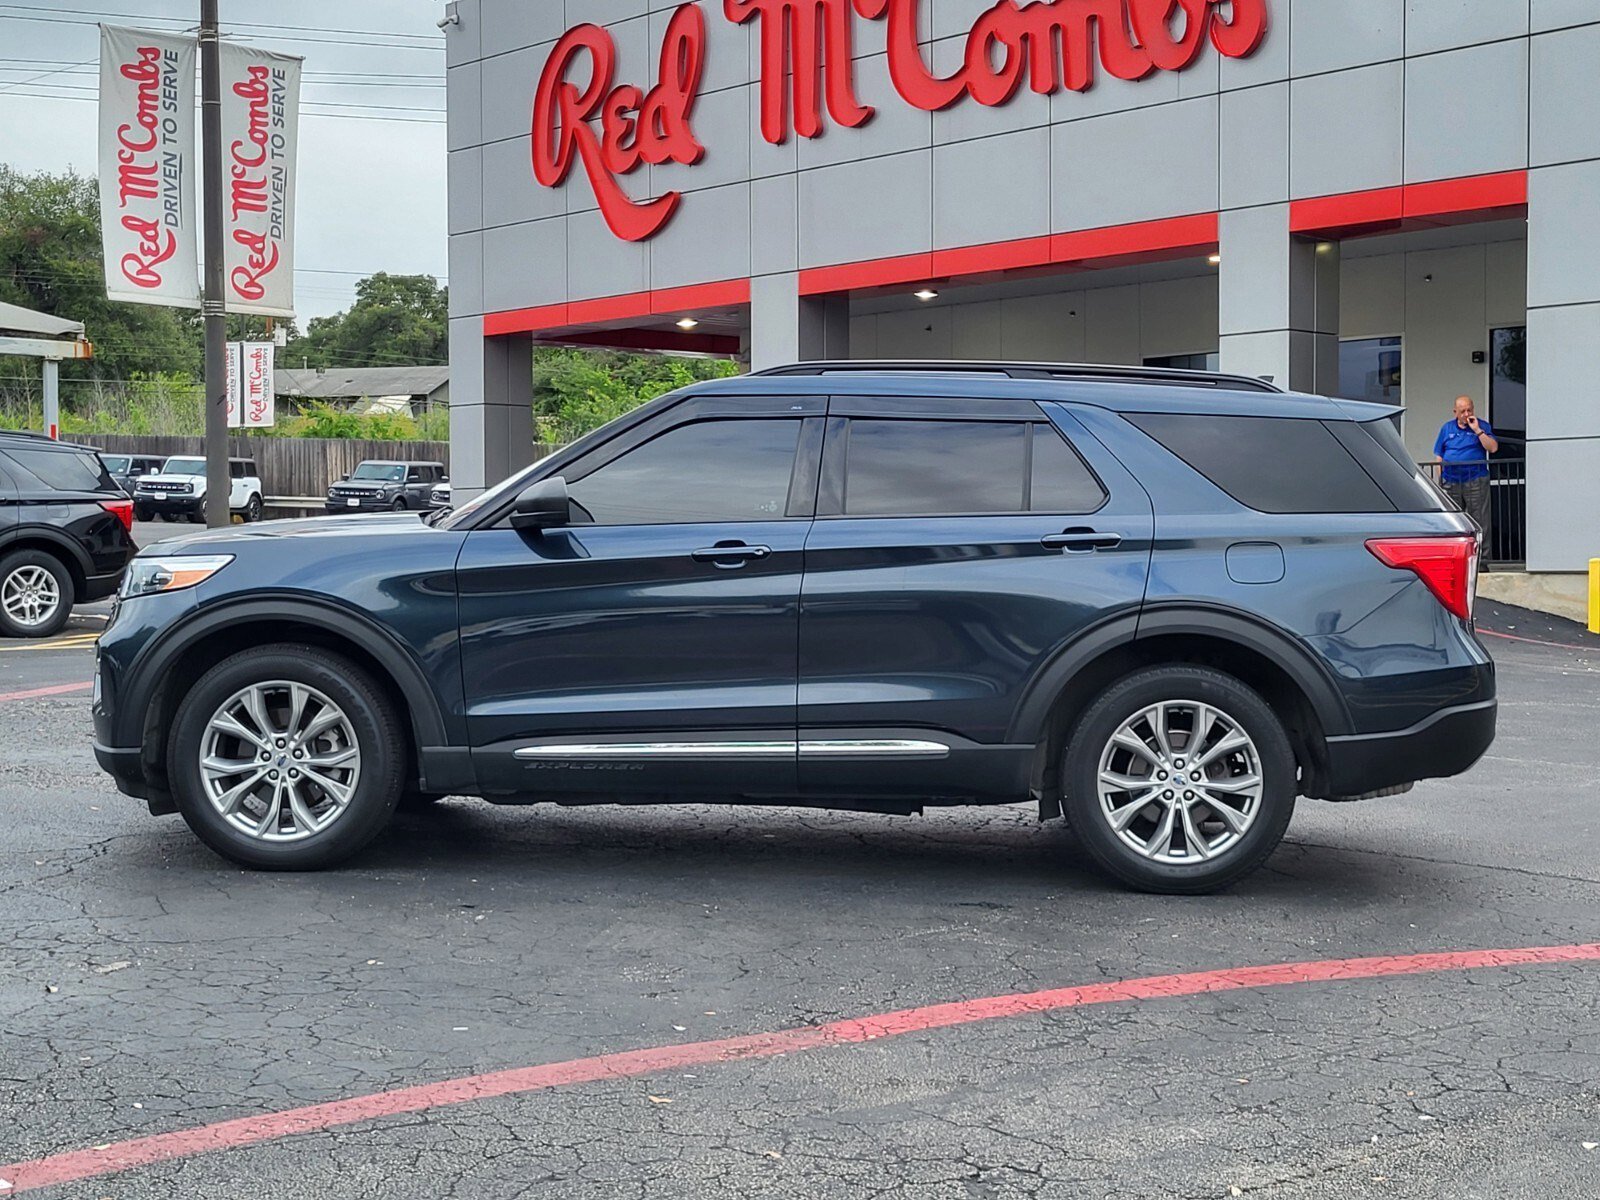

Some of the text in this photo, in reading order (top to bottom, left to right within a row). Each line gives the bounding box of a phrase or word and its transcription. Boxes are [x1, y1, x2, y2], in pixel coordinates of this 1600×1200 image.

[117, 46, 177, 288] Red McCombs
[162, 49, 179, 228] DRIVEN TO SERVE
[230, 65, 279, 300] Red McCombs
[270, 68, 286, 240] DRIVEN TO SERVE
[531, 0, 1268, 242] Red MComs
[249, 348, 267, 421] Red McCombs
[524, 762, 645, 770] EXPLORER
